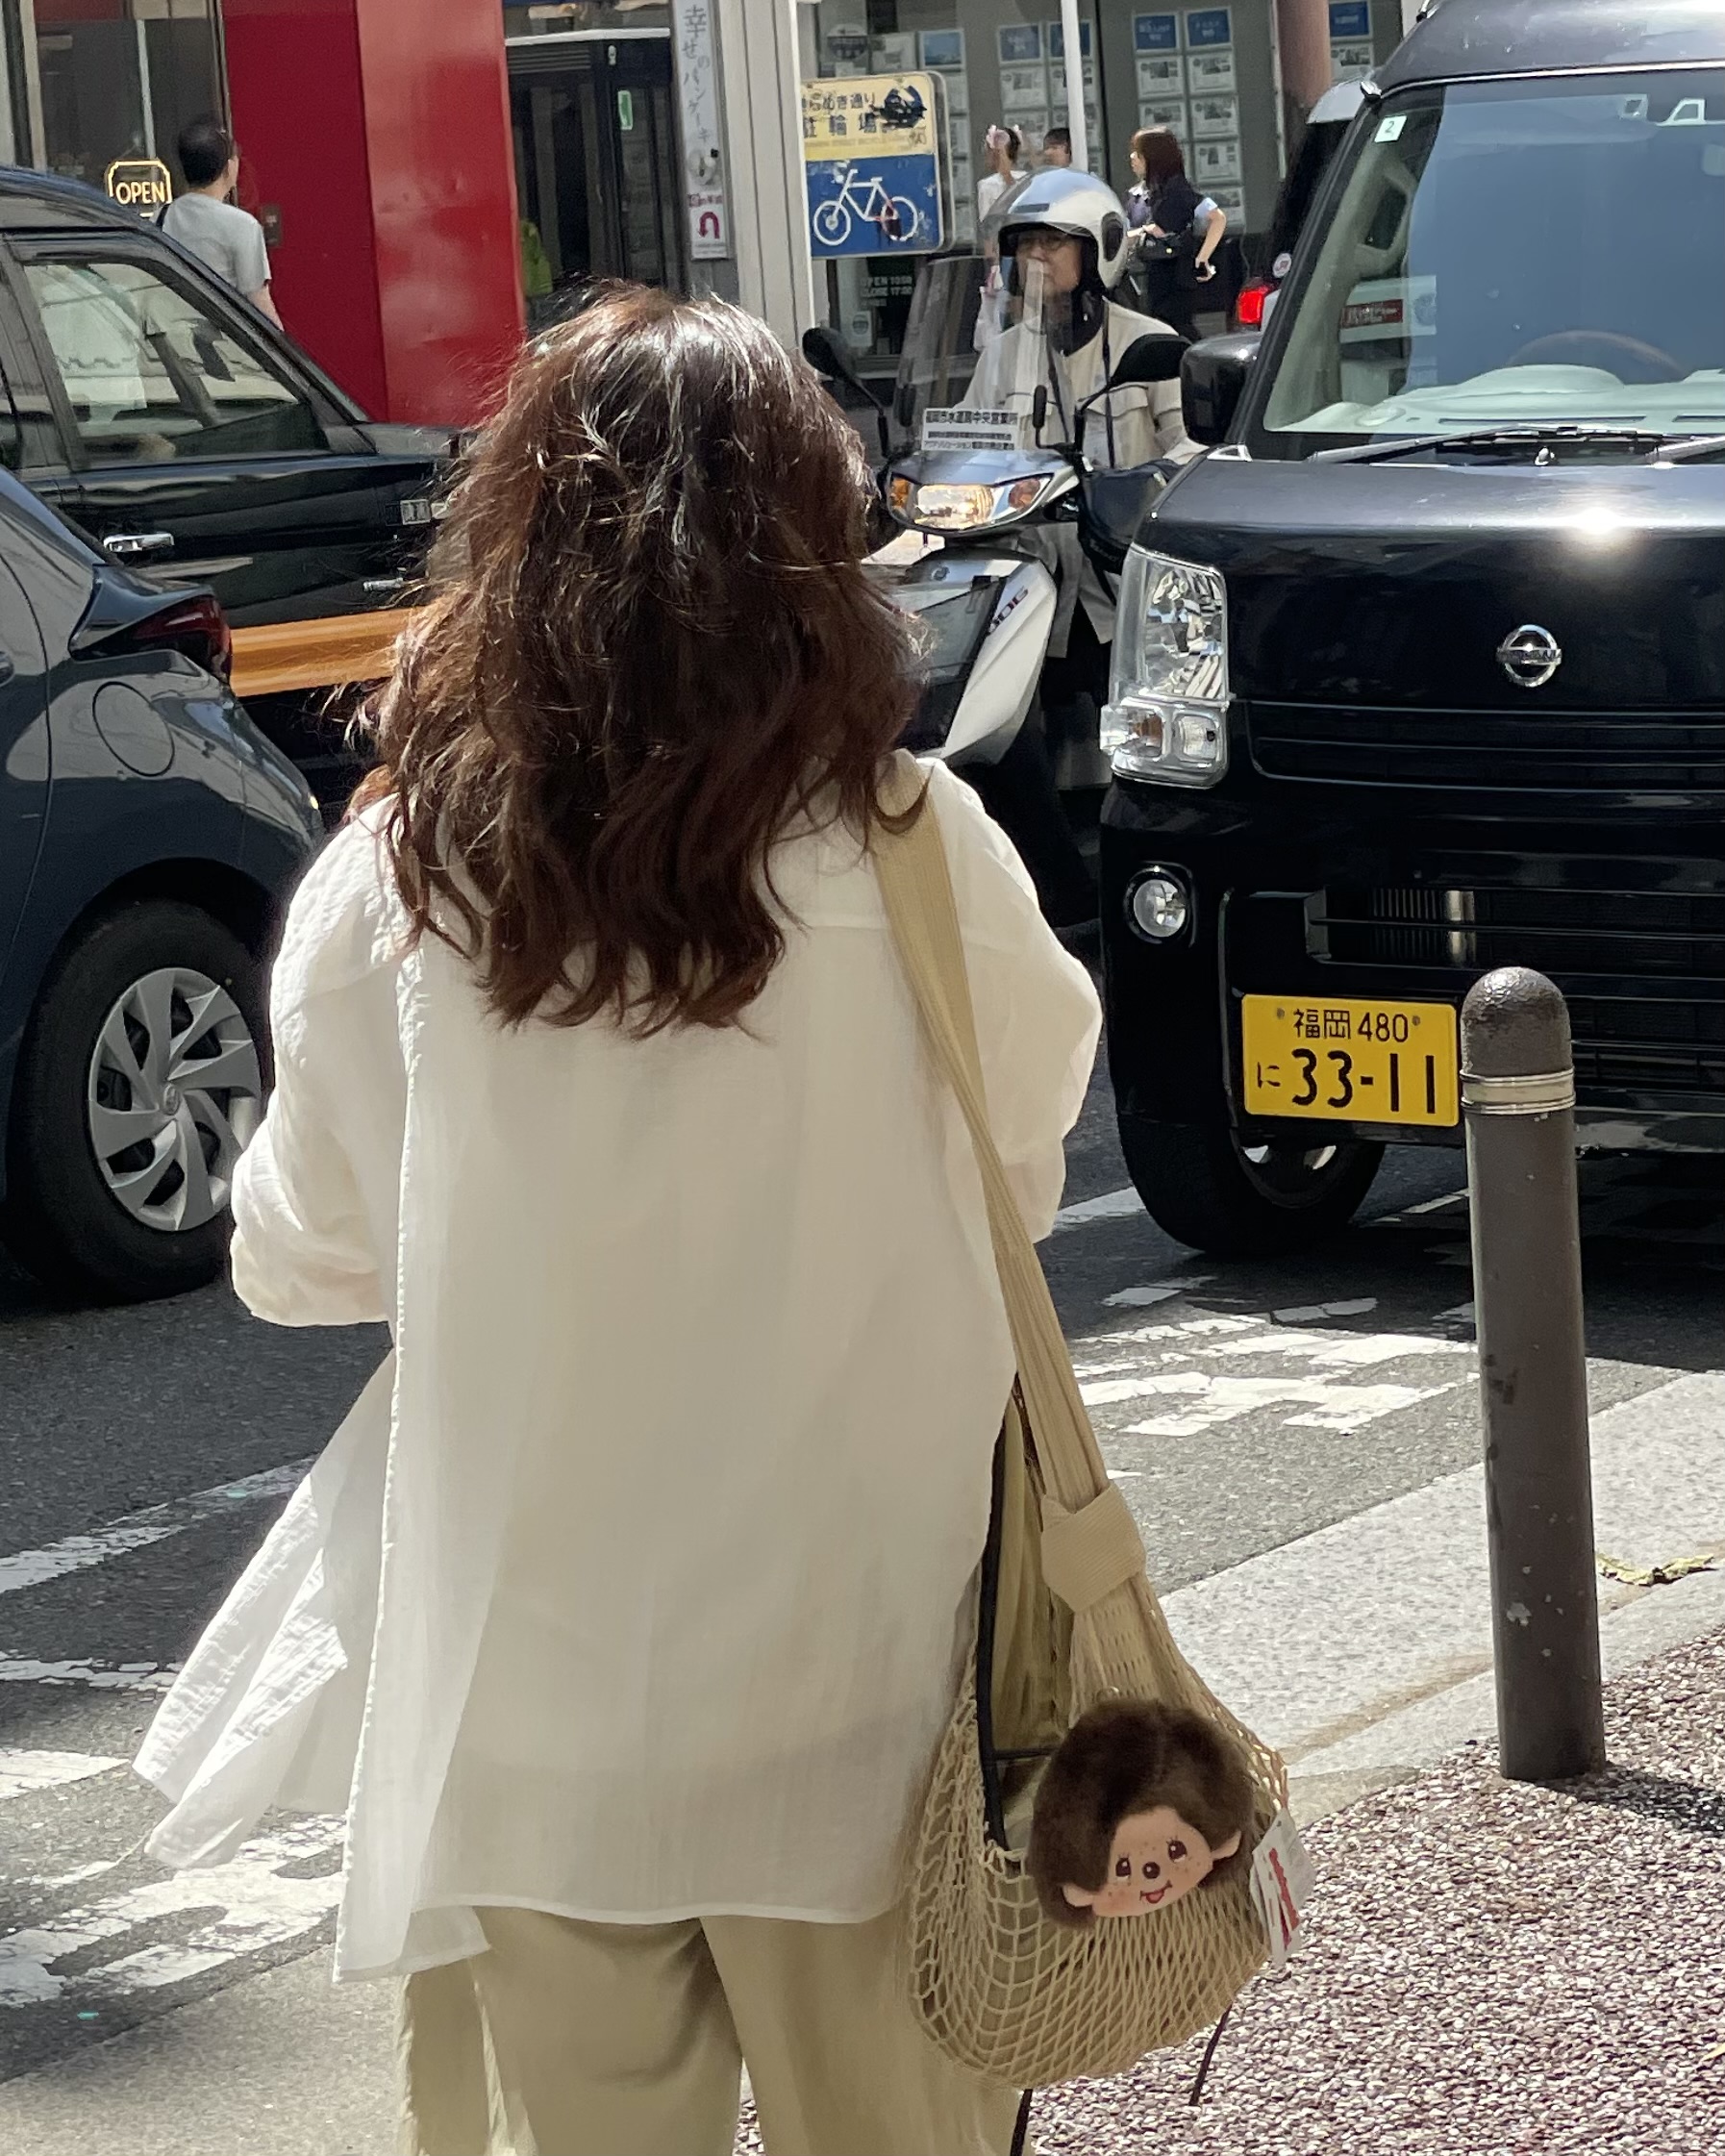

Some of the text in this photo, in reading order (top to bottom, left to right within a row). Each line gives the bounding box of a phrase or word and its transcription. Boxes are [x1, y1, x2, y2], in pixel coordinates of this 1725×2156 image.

[682, 3, 711, 143] 幸せのパンケーキ
[115, 181, 166, 205] OPEN
[1293, 1008, 1409, 1043] 福岡 480
[1257, 1048, 1437, 1115] に 33-11
